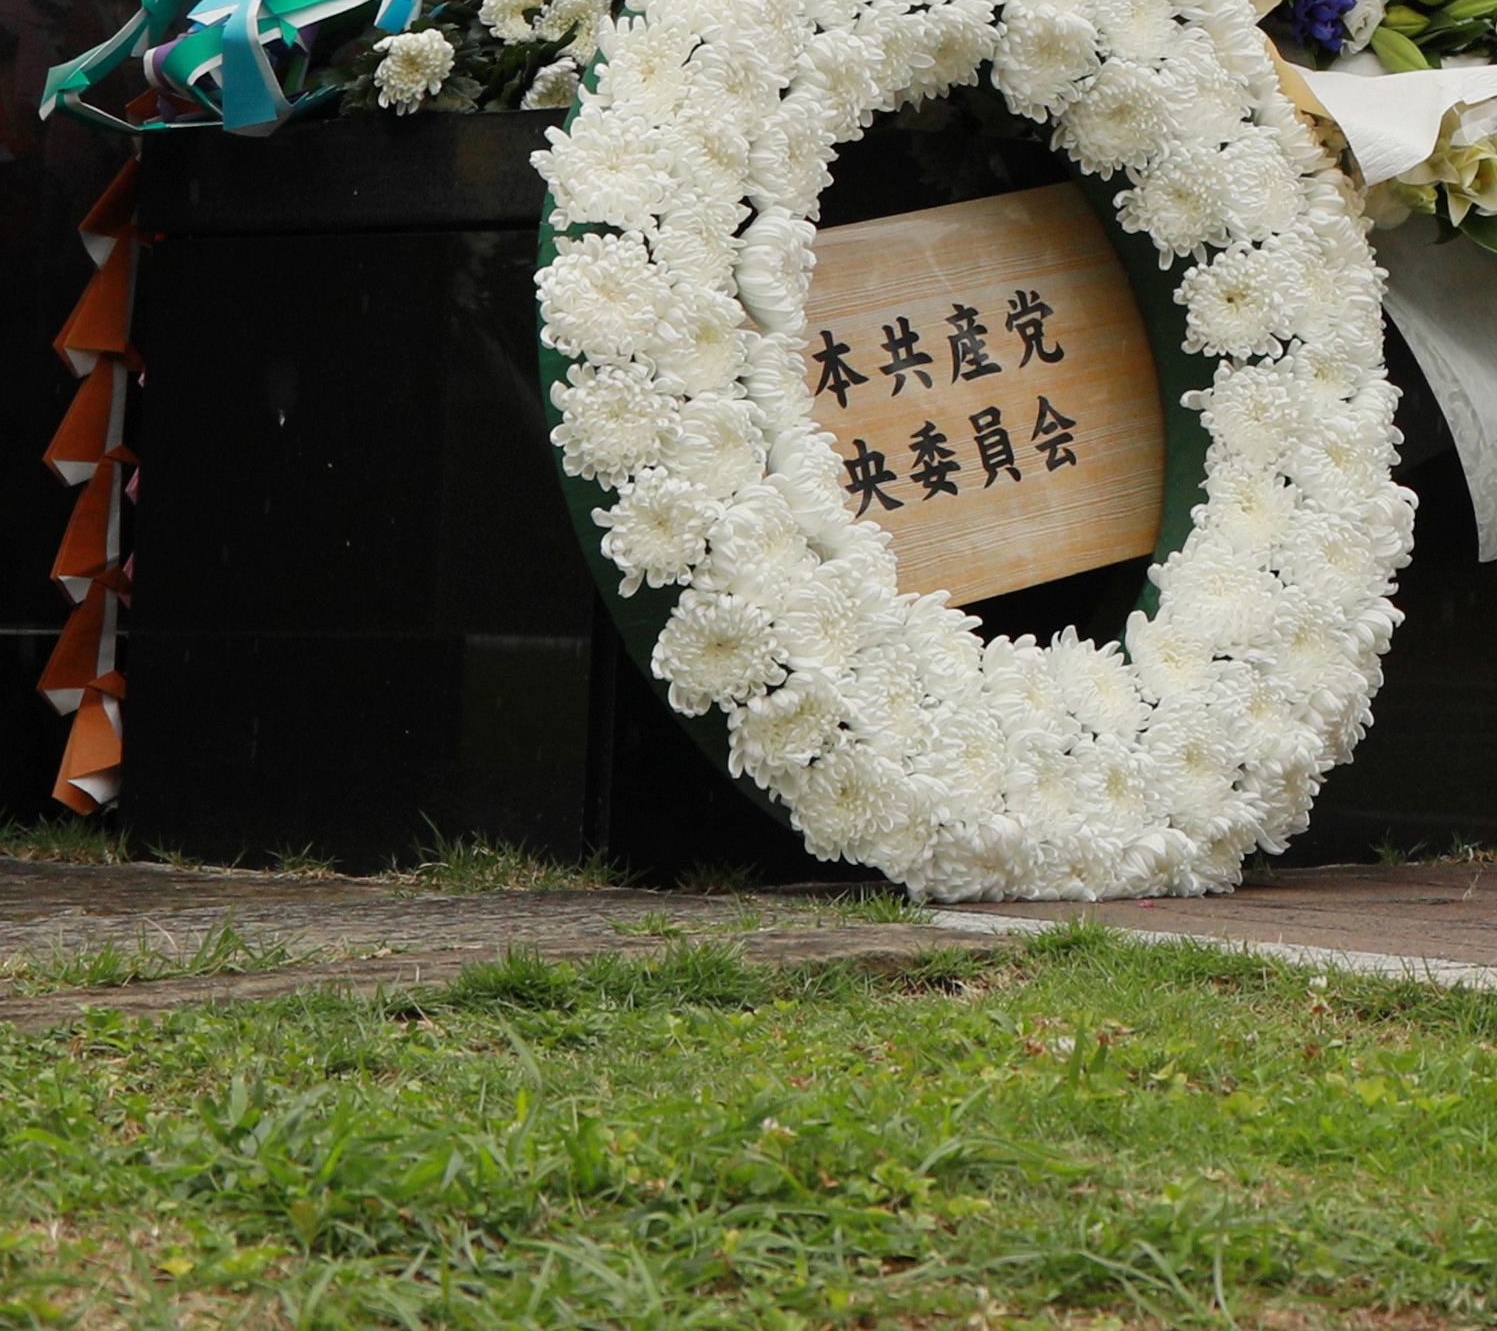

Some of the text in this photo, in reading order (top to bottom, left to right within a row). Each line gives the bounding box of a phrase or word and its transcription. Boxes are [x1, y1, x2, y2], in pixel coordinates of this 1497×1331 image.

[811, 289, 1066, 409] 本共産党
[842, 395, 1078, 519] 央委員会
